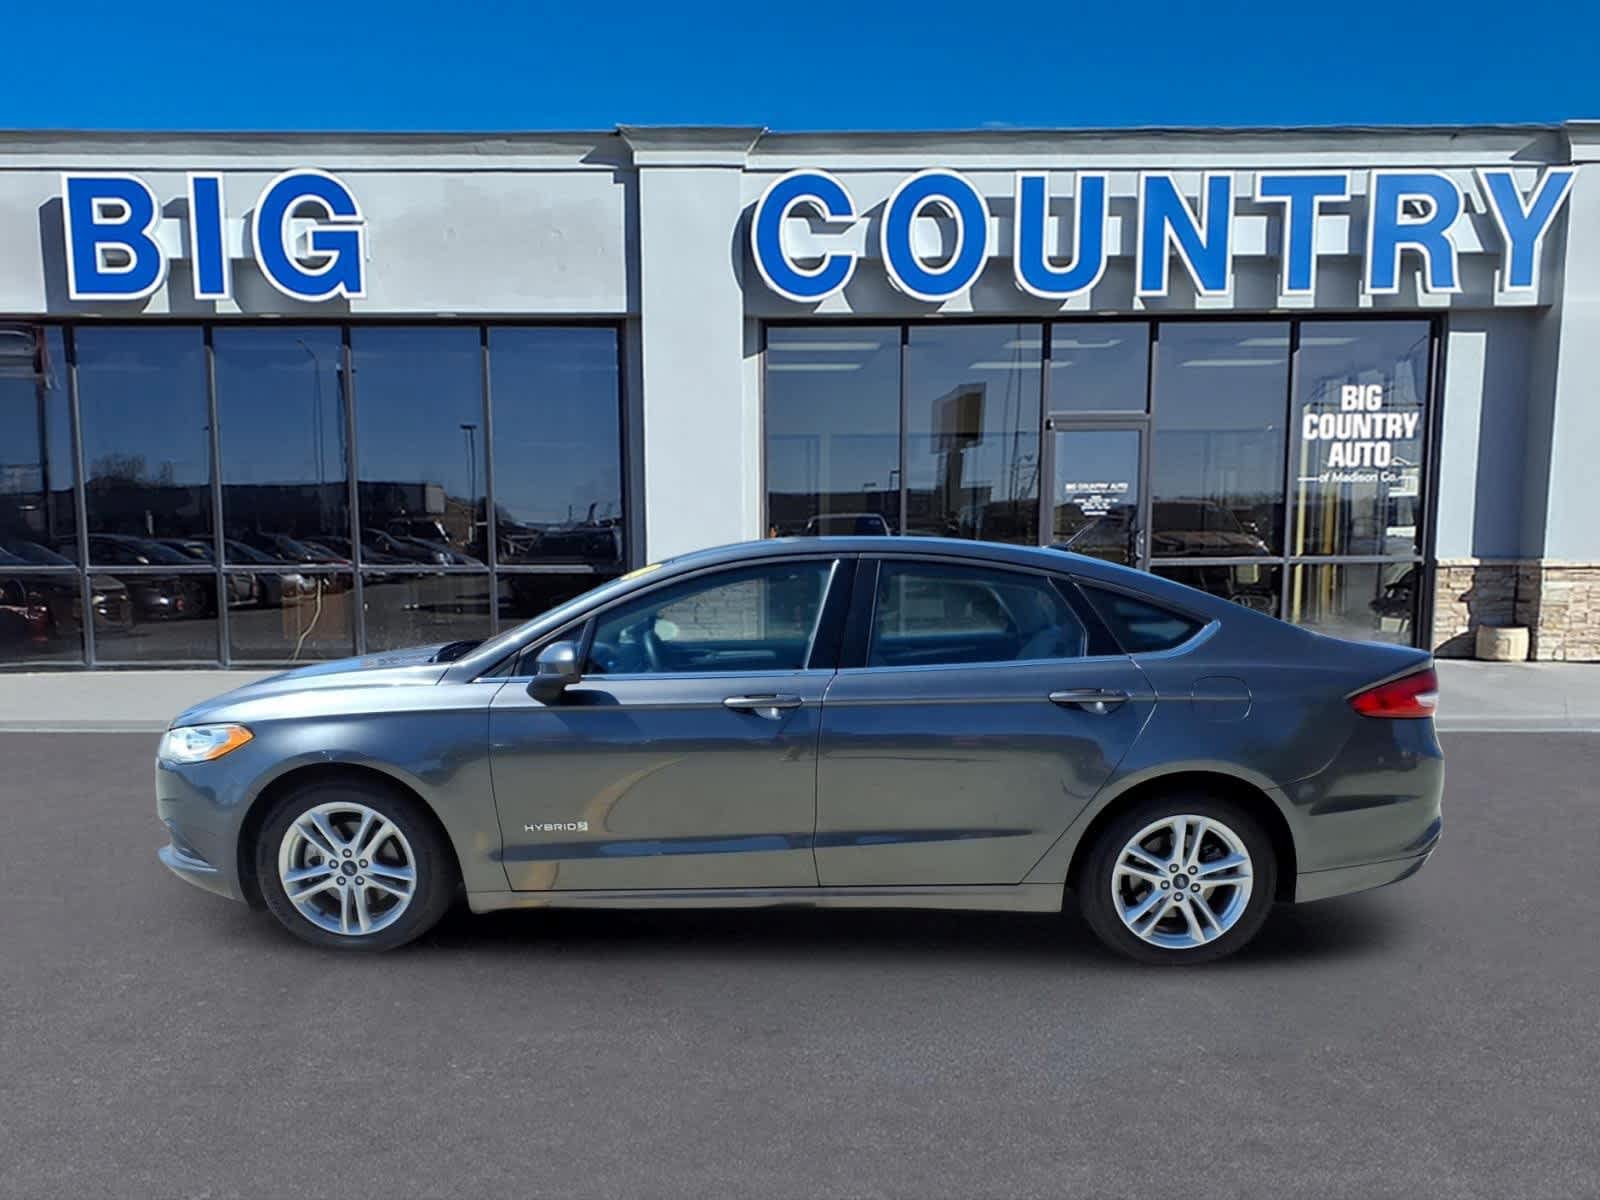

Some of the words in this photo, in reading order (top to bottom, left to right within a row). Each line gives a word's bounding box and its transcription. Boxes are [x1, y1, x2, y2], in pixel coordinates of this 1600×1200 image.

[61, 169, 367, 302] BIG
[751, 167, 1575, 304] COUNTRY
[1341, 384, 1383, 411] BIG
[1302, 412, 1419, 440] COUNTRY
[1328, 441, 1392, 468] AUTO
[1319, 472, 1329, 482] of
[1332, 471, 1378, 482] Madison
[524, 823, 577, 832] HYBRID
